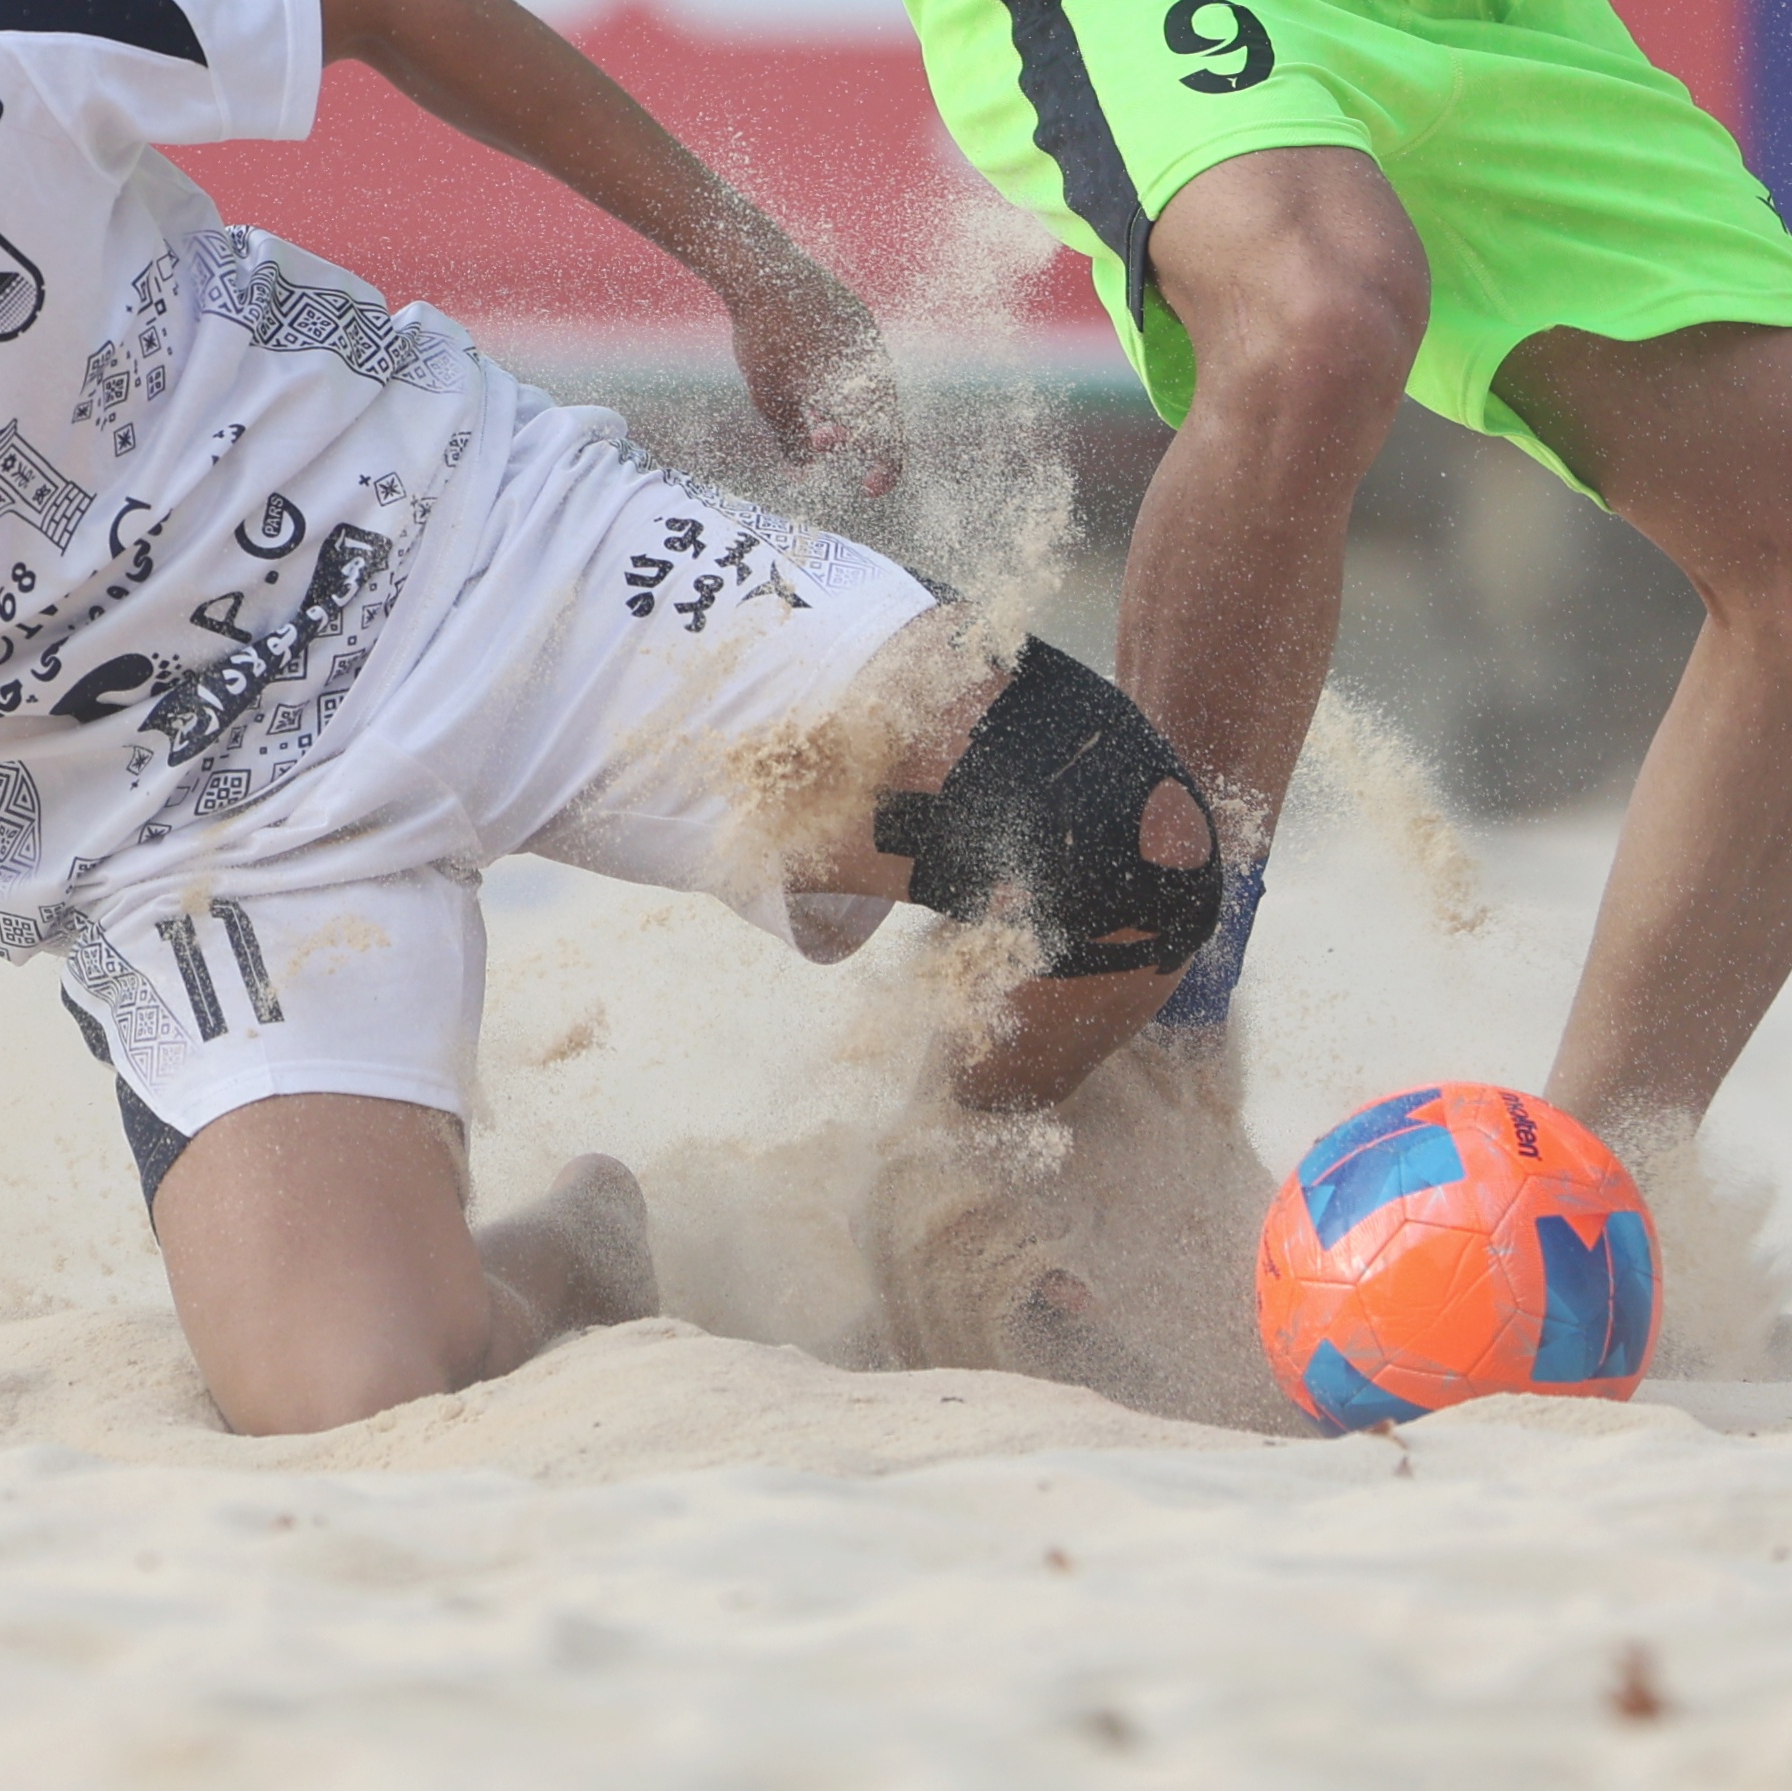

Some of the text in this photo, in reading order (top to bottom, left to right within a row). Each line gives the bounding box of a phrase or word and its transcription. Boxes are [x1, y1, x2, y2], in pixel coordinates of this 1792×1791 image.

[263, 493, 285, 537] PARS
[623, 515, 707, 619] فولاد
[673, 530, 760, 634] سرمد
[155, 896, 286, 1043] 11
[1497, 1091, 1540, 1158] molten
